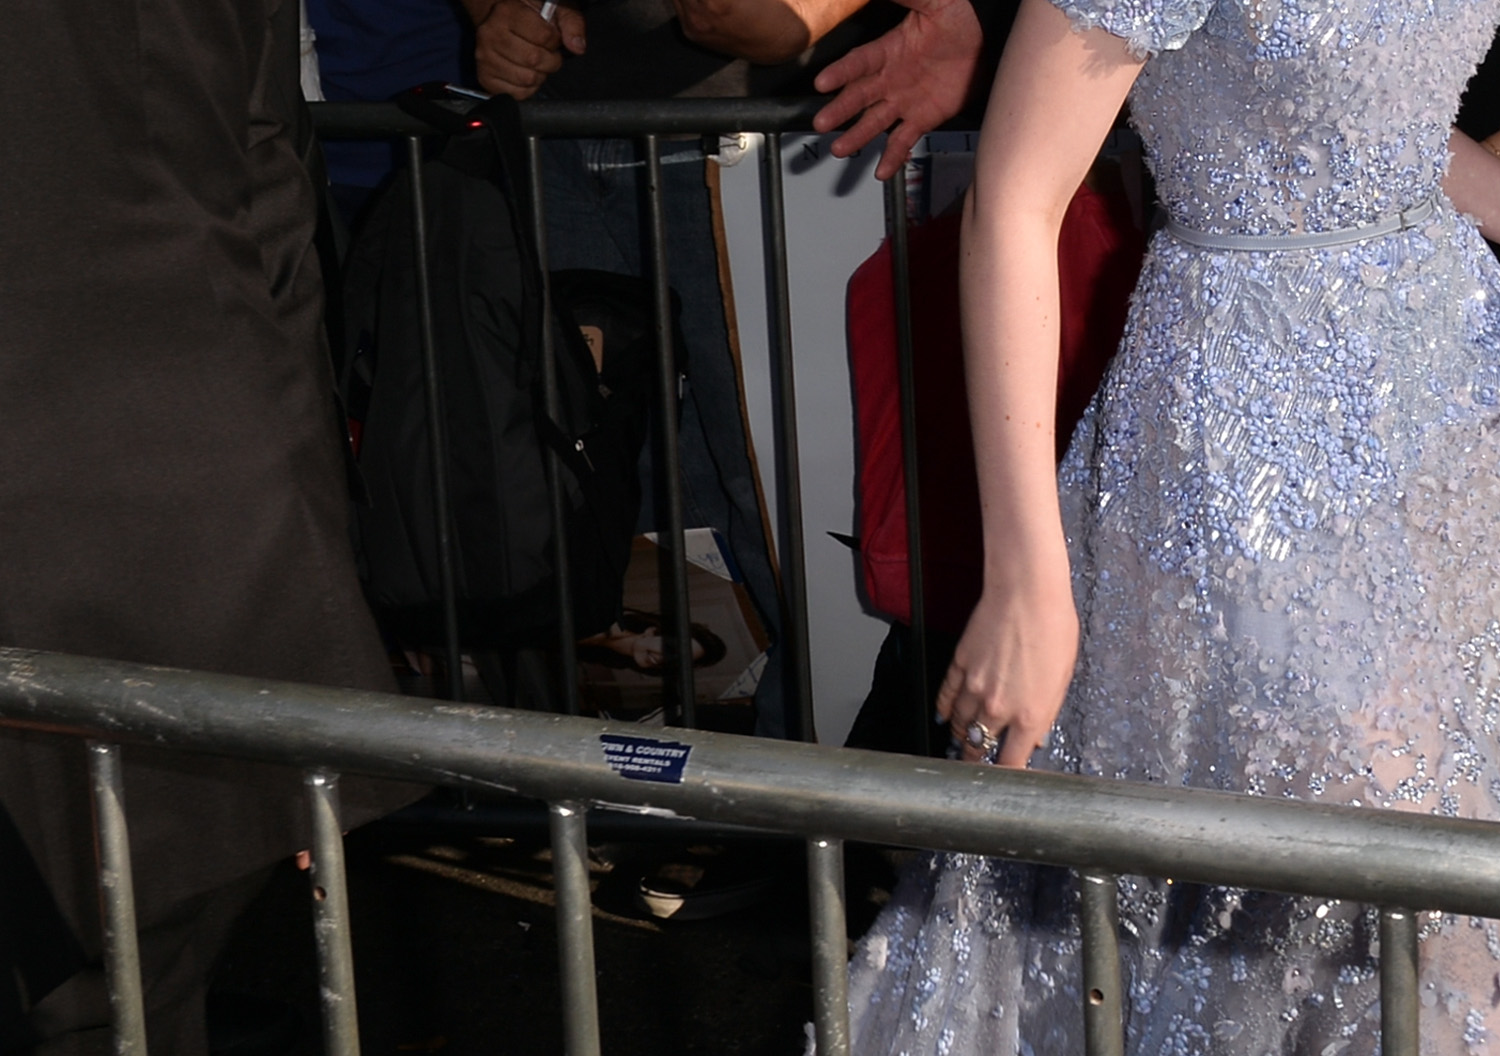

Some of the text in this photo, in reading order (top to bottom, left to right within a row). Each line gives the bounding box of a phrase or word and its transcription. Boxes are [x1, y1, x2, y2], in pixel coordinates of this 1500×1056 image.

[625, 745, 634, 754] &
[635, 746, 687, 759] COUNTRY
[631, 756, 672, 767] RENTALS
